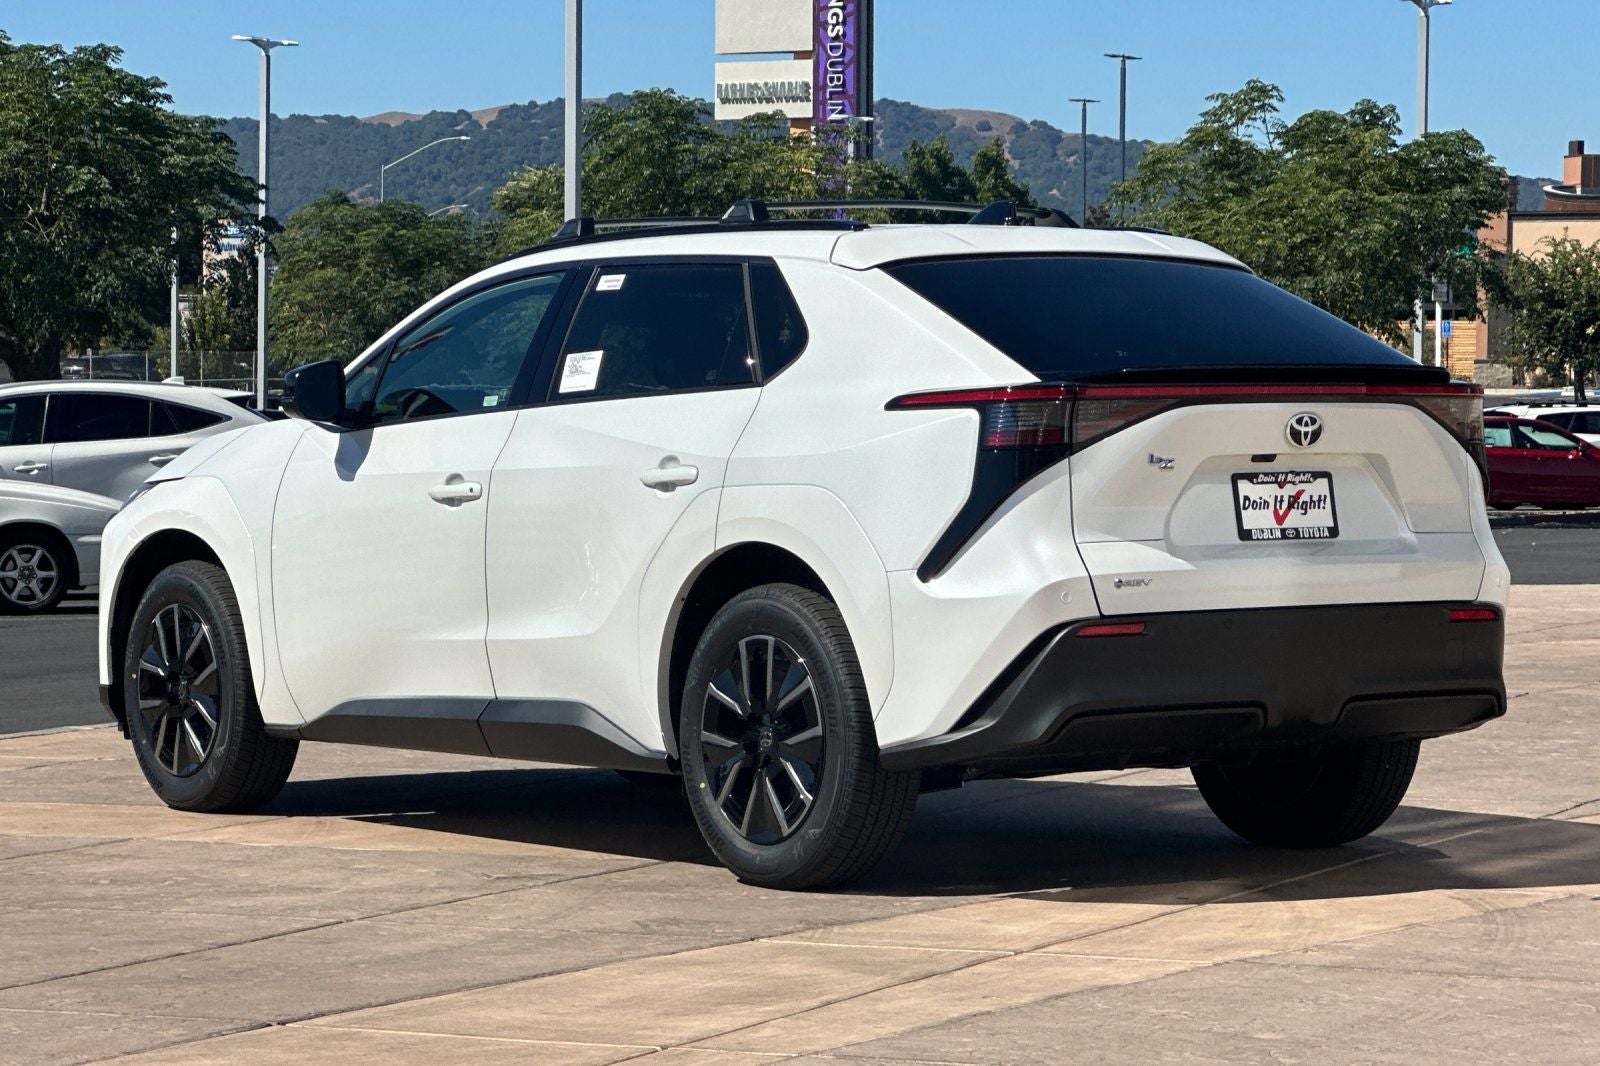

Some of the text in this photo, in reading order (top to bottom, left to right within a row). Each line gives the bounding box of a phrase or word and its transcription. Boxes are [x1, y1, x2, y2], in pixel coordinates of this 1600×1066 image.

[827, 42, 844, 122] DUBLIN
[1251, 527, 1330, 540] DUBLIN TOYOTA
